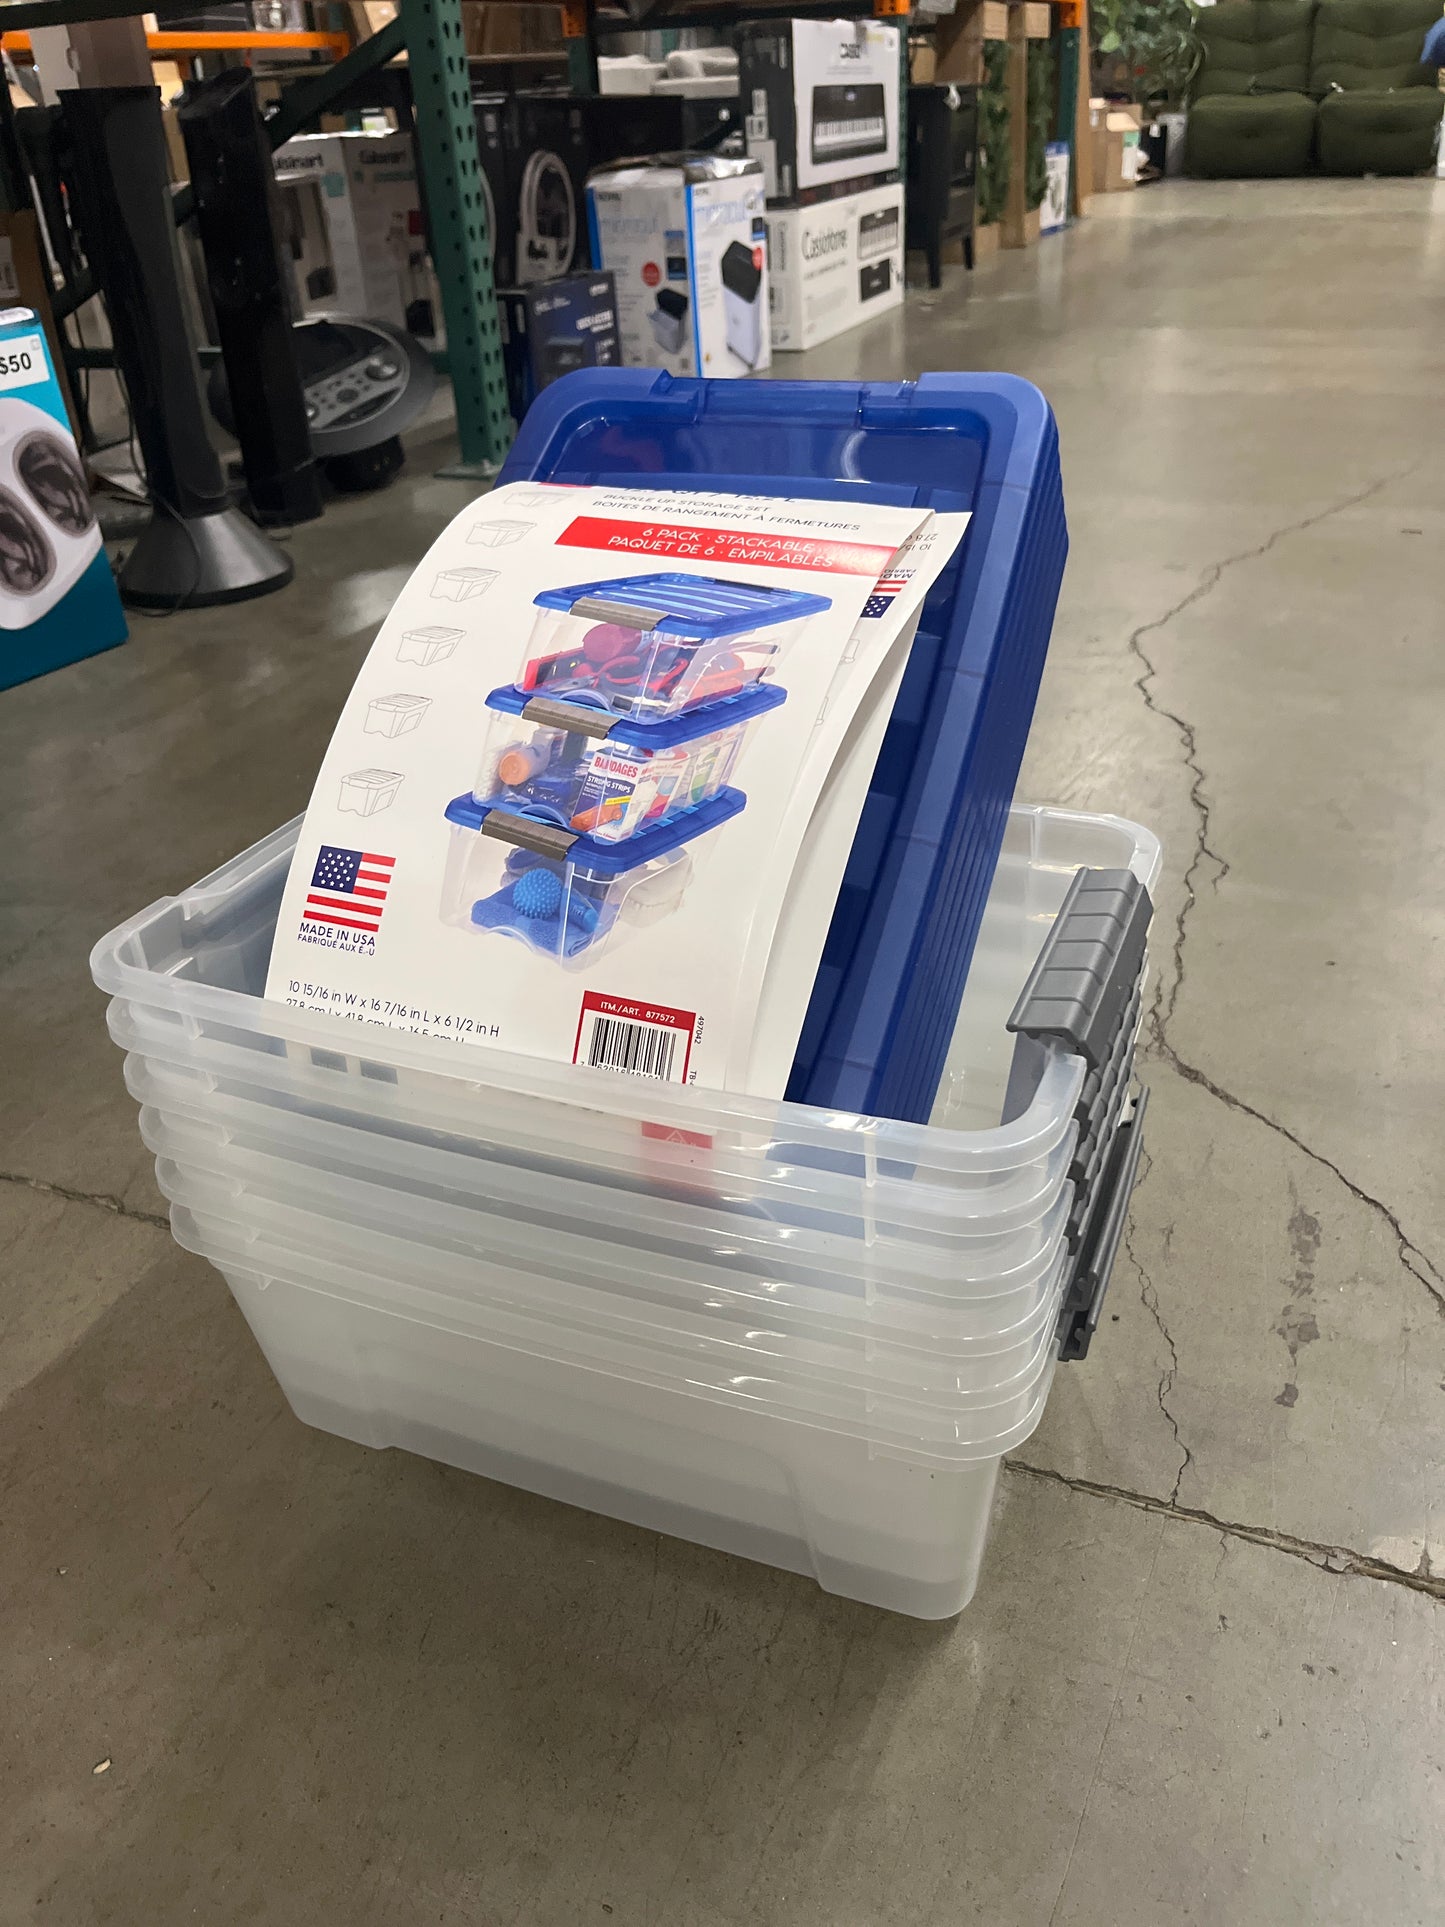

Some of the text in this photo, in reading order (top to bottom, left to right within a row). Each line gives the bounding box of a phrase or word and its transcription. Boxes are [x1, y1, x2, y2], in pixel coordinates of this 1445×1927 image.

[603, 494, 655, 503] BUCKLE
[678, 500, 743, 510] STORAGE
[641, 504, 661, 512] DE
[662, 507, 752, 519] RANGEMENT
[768, 516, 861, 531] FERMETURES
[607, 536, 833, 568] PAQUET DE 6 EMPILABLES
[642, 528, 815, 553] 6 PACK STACKABLE
[611, 782, 631, 794] STRIPS
[299, 922, 375, 947] MADE IN USA
[339, 943, 356, 953] AUX
[289, 980, 500, 1037] 10 15/16 in W x 16 7/16 in L x 6 1/2 in H
[600, 1001, 675, 1024] ITM./ART. 877572
[694, 1016, 705, 1044] 497042
